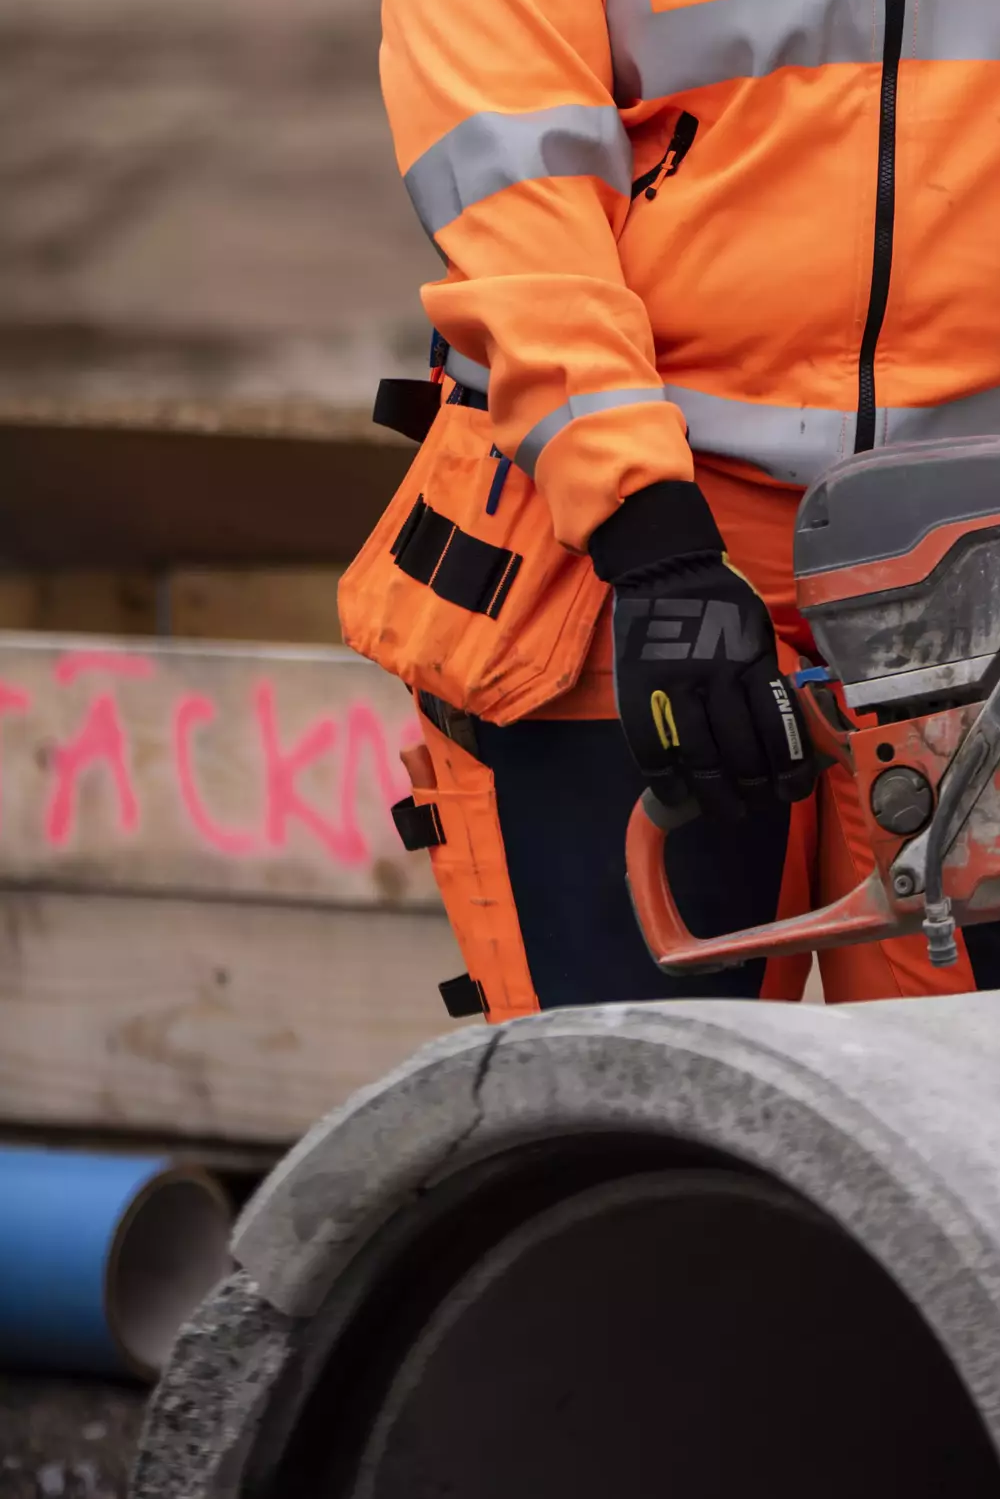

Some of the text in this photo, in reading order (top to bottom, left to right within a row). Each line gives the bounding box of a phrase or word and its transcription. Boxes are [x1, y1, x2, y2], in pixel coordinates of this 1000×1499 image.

[615, 598, 760, 662] TEN
[769, 678, 793, 712] TEN
[0, 649, 424, 868] ÄCKN
